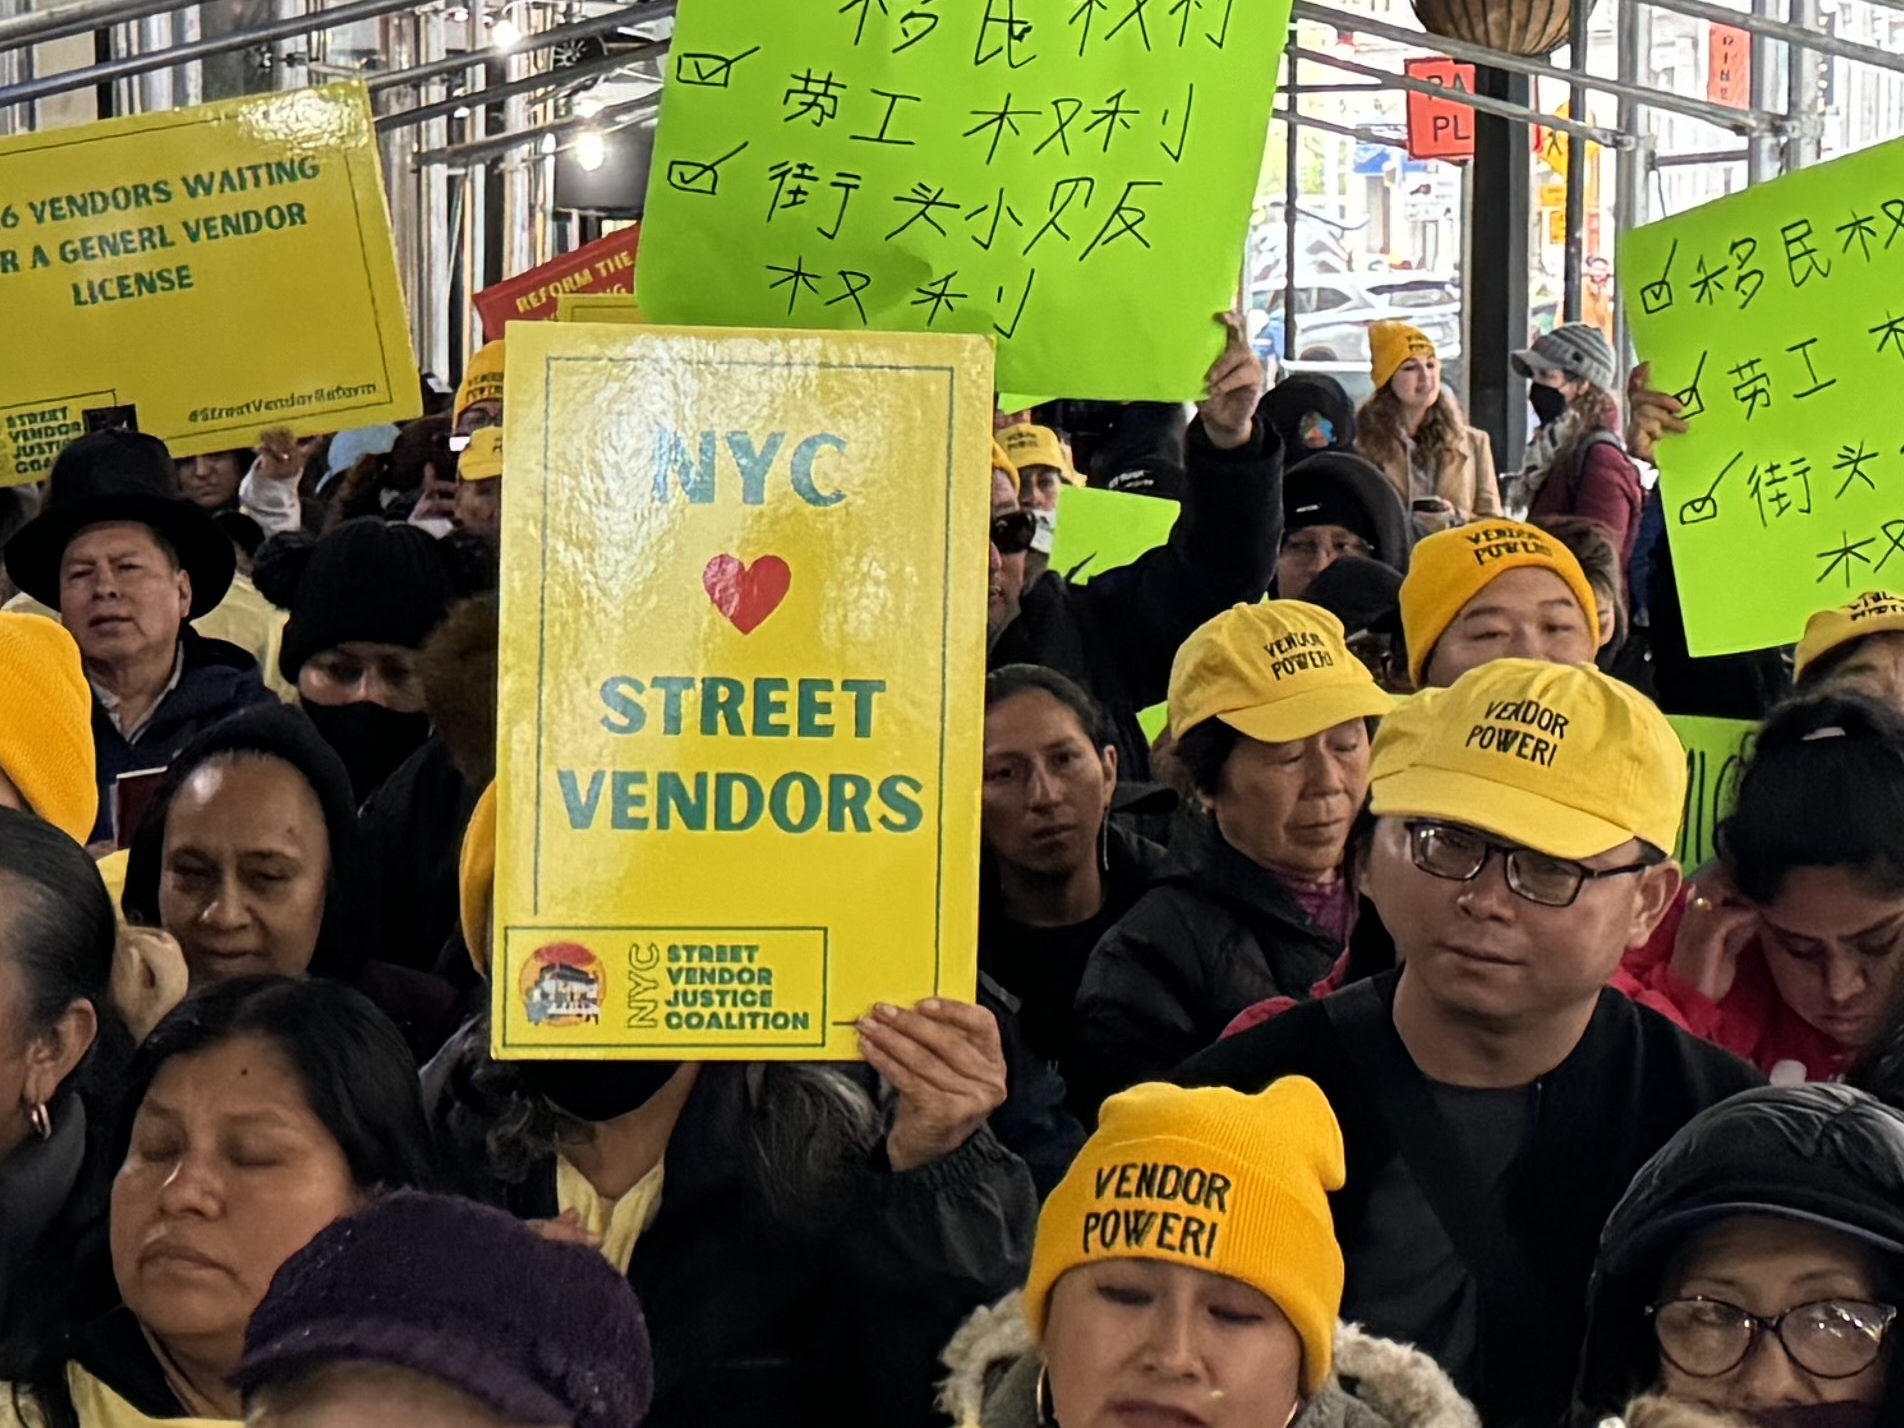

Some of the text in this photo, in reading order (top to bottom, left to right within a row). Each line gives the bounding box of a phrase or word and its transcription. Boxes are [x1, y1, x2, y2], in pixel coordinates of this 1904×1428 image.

[783, 69, 1195, 165] 劳工权利
[28, 179, 173, 226] VENDORS
[180, 155, 321, 200] WAITING
[766, 161, 1164, 261] 街头小贩
[30, 244, 52, 270] A
[59, 223, 176, 265] GENERL
[182, 201, 308, 243] VENDOR
[71, 264, 195, 307] LICENSE
[515, 250, 634, 314] REFORM THE
[8, 420, 82, 444] VENDOR
[650, 430, 849, 509] NYC
[1263, 631, 1326, 658] VENDOR
[598, 675, 888, 740] STREET
[1484, 699, 1570, 740] VENDOR
[555, 769, 924, 835] VENDORS
[666, 943, 760, 964] STREET
[666, 966, 774, 986] VENDOR
[627, 942, 660, 1030] NYC
[664, 989, 773, 1008] JUSTICE
[664, 1011, 810, 1030] COALITION
[1095, 1161, 1232, 1214] VENDOR
